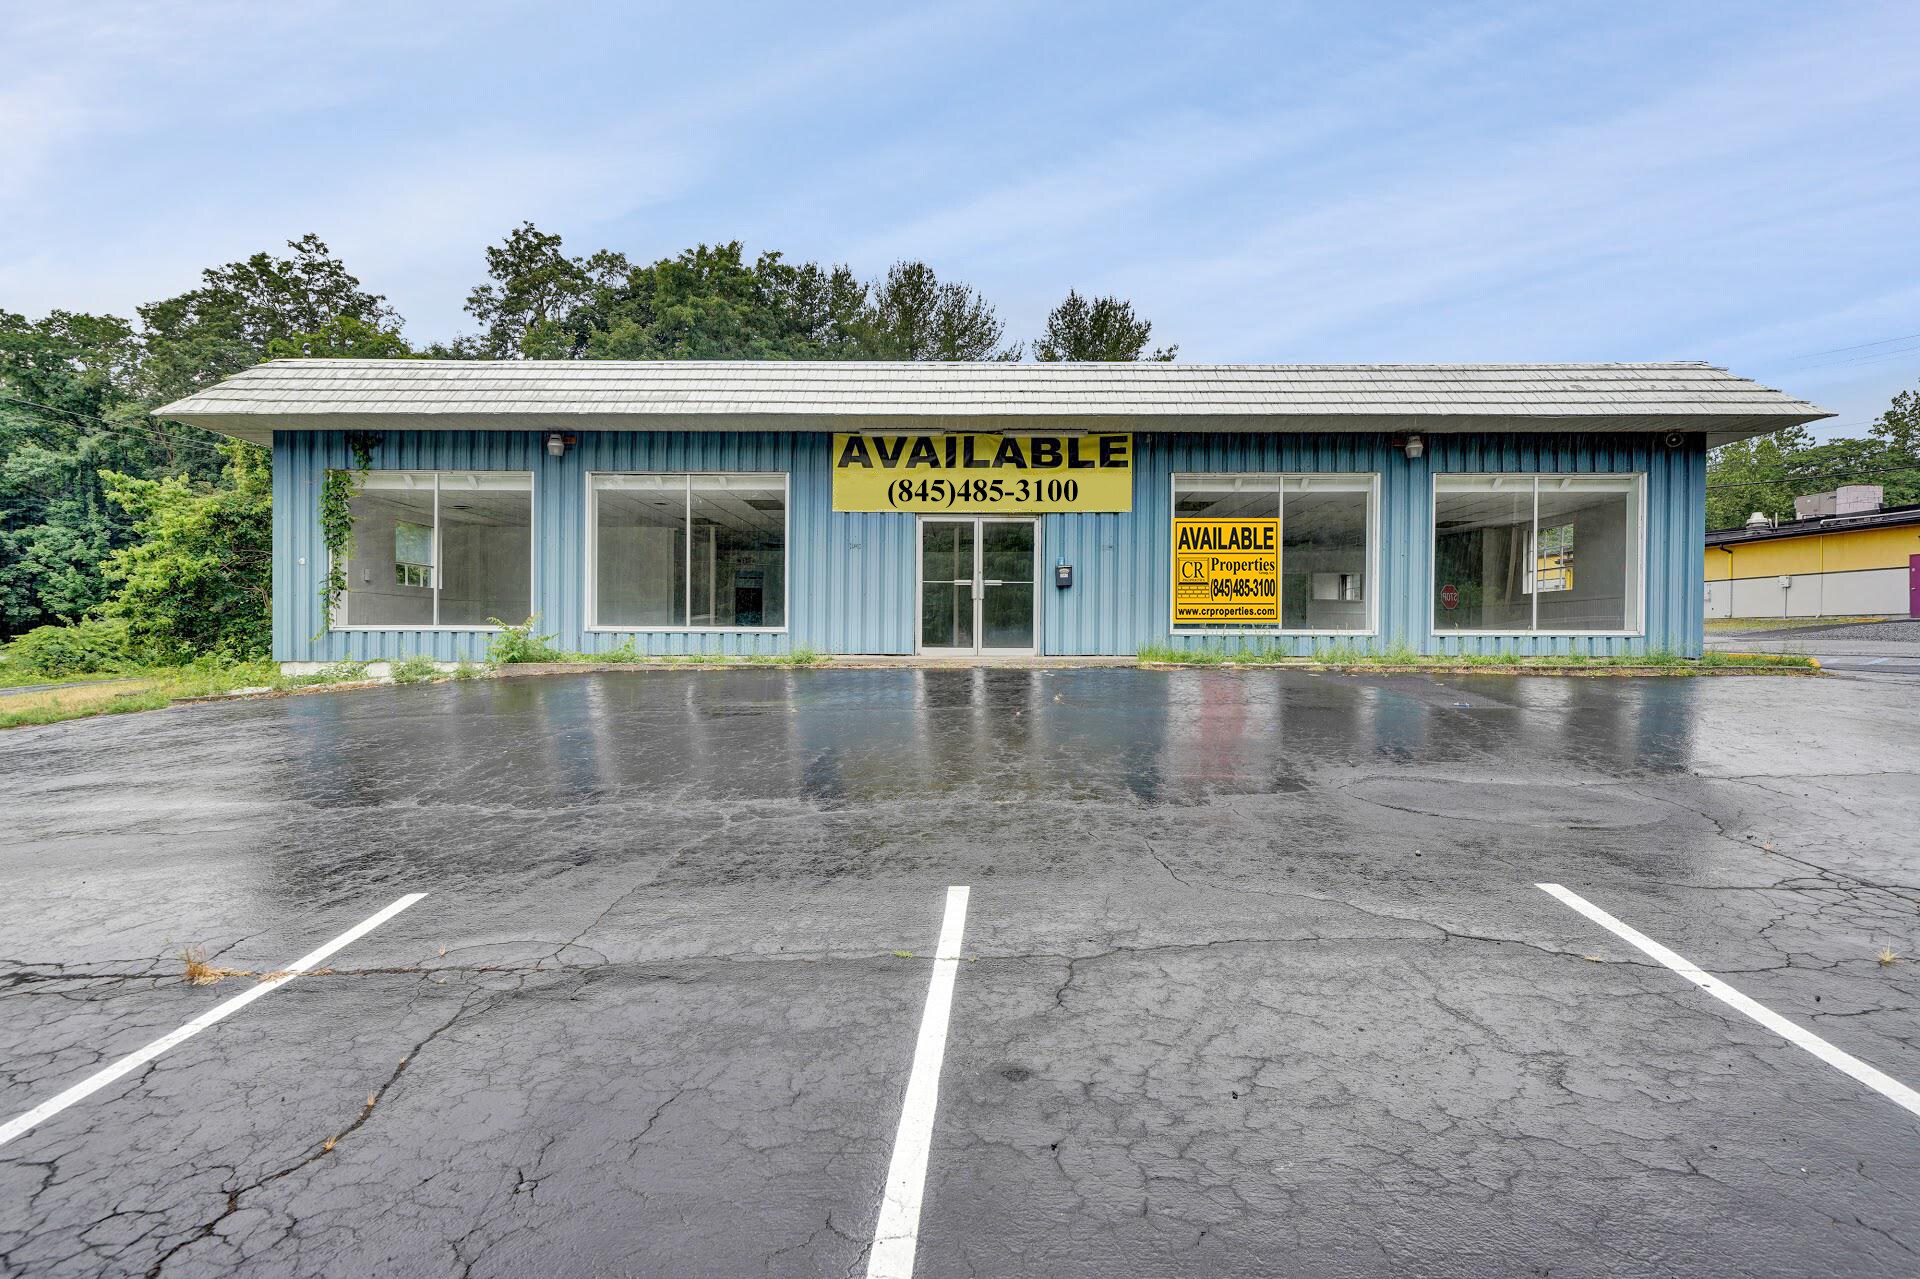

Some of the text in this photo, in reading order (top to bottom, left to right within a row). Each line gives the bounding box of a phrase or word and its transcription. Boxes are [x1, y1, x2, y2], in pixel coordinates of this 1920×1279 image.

[837, 435, 1129, 469] AVAILABLE
[887, 479, 1079, 508] (845)485-3100
[1178, 527, 1274, 550] AVAILABLE
[1182, 561, 1205, 579] CR
[1211, 557, 1275, 575] Properties
[1210, 578, 1276, 601] (845)485-3100
[1178, 606, 1275, 617] www.crproperties.com
